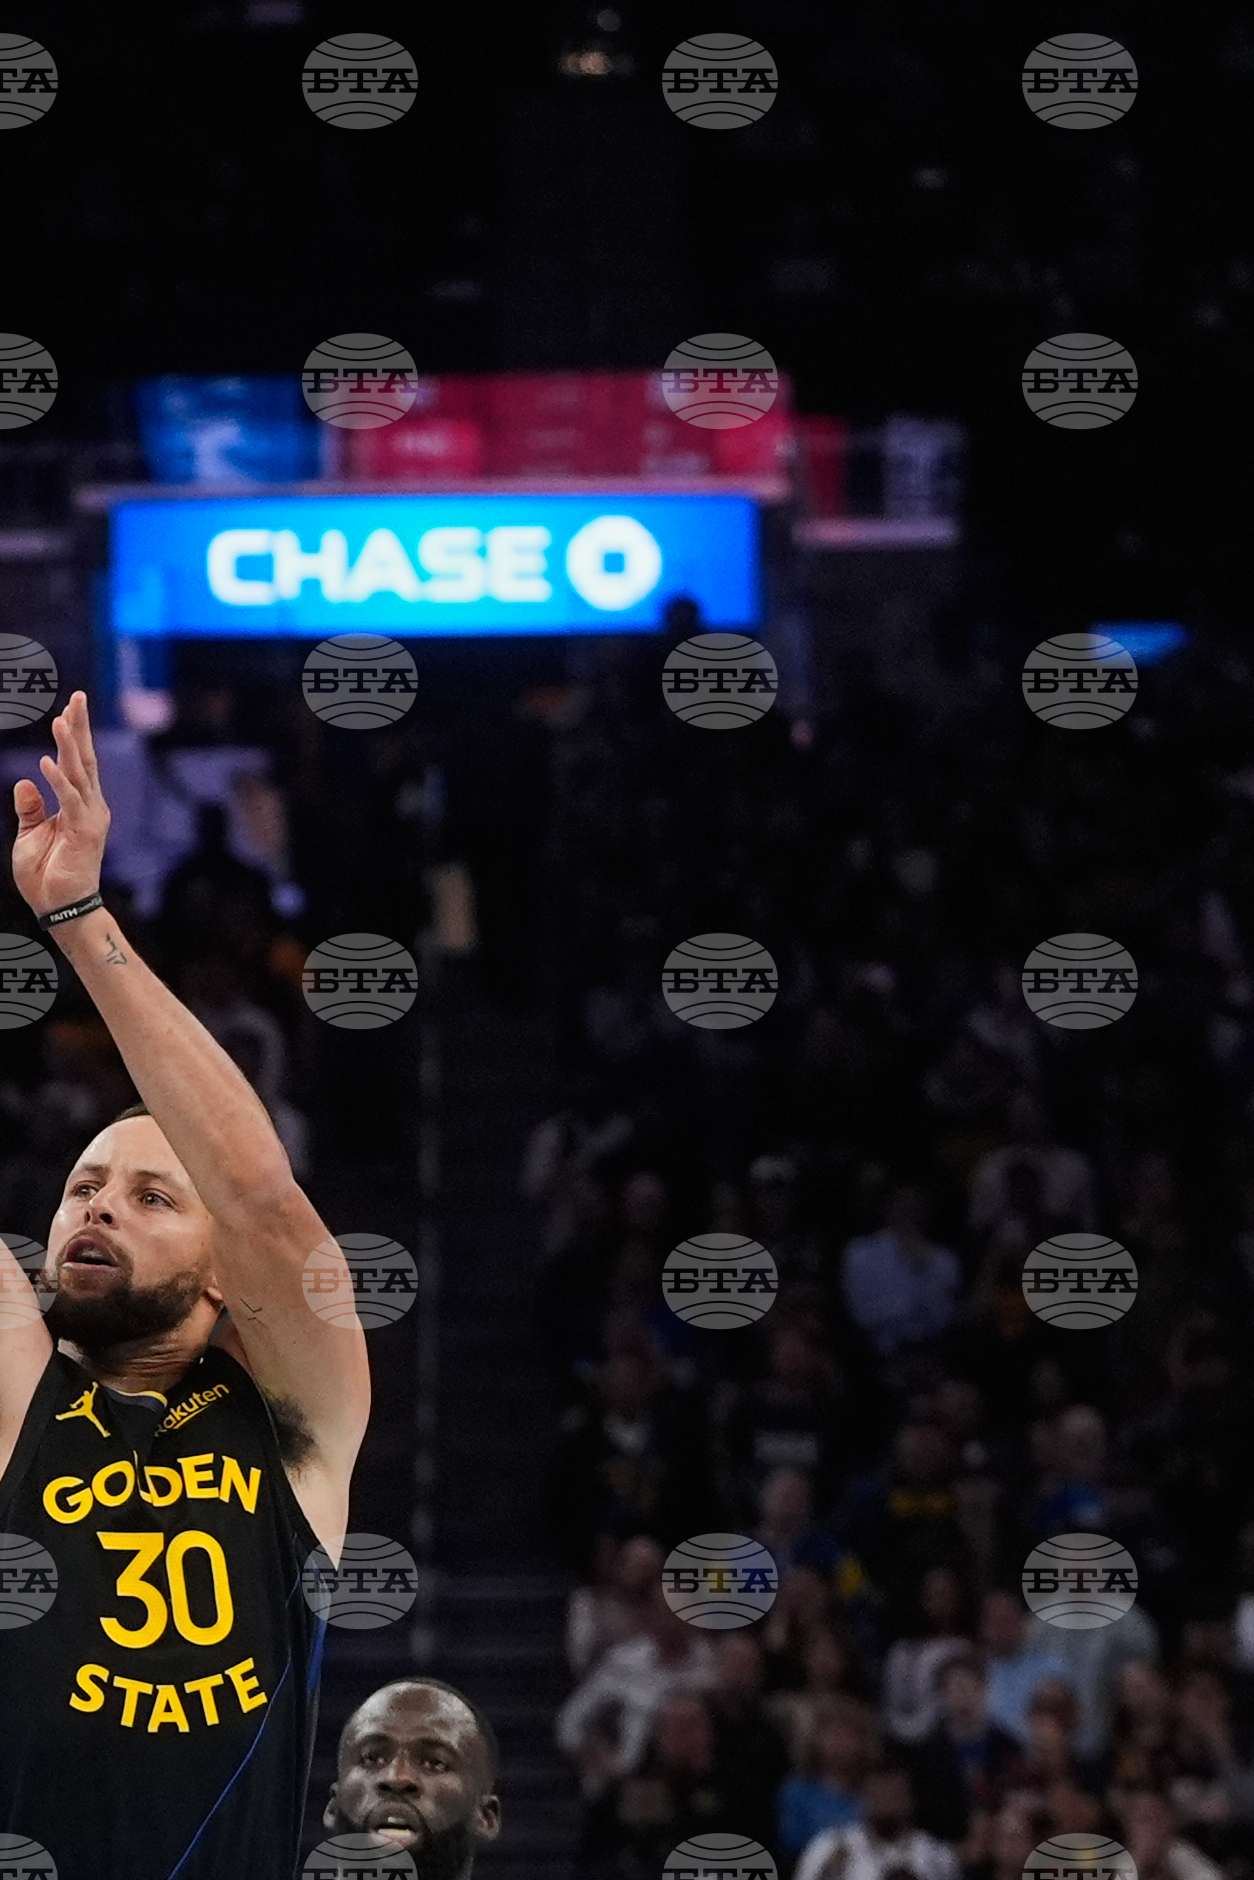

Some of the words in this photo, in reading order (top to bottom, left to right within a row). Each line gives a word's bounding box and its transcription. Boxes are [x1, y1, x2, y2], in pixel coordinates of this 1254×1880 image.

[207, 525, 553, 606] CHASE
[96, 1529, 234, 1649] 30
[68, 1657, 268, 1733] STATE
